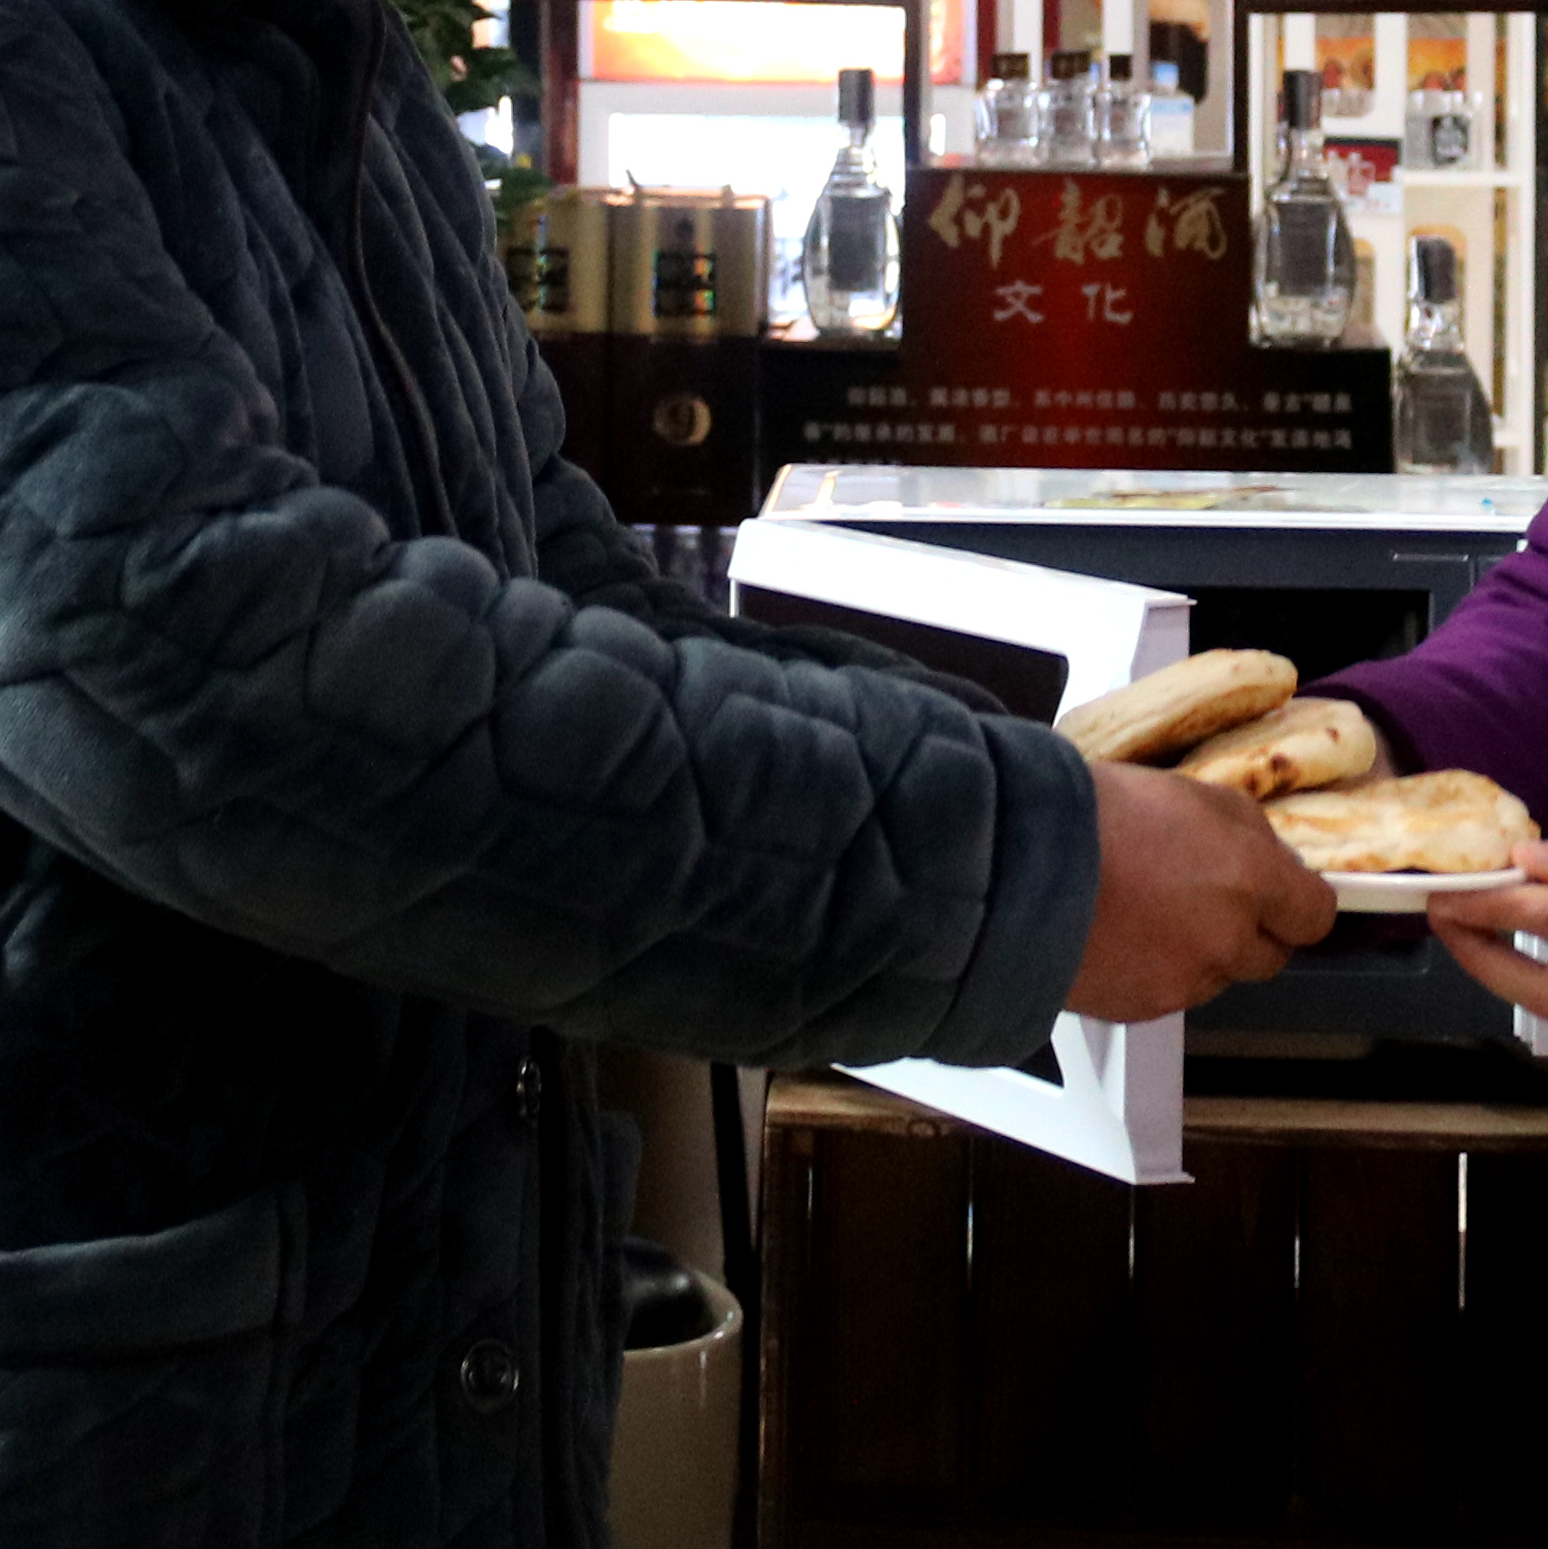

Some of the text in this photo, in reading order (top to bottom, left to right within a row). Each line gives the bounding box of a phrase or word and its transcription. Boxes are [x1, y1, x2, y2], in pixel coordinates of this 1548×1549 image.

[928, 173, 1228, 268] 仰韶酒
[992, 280, 1135, 325] 文化
